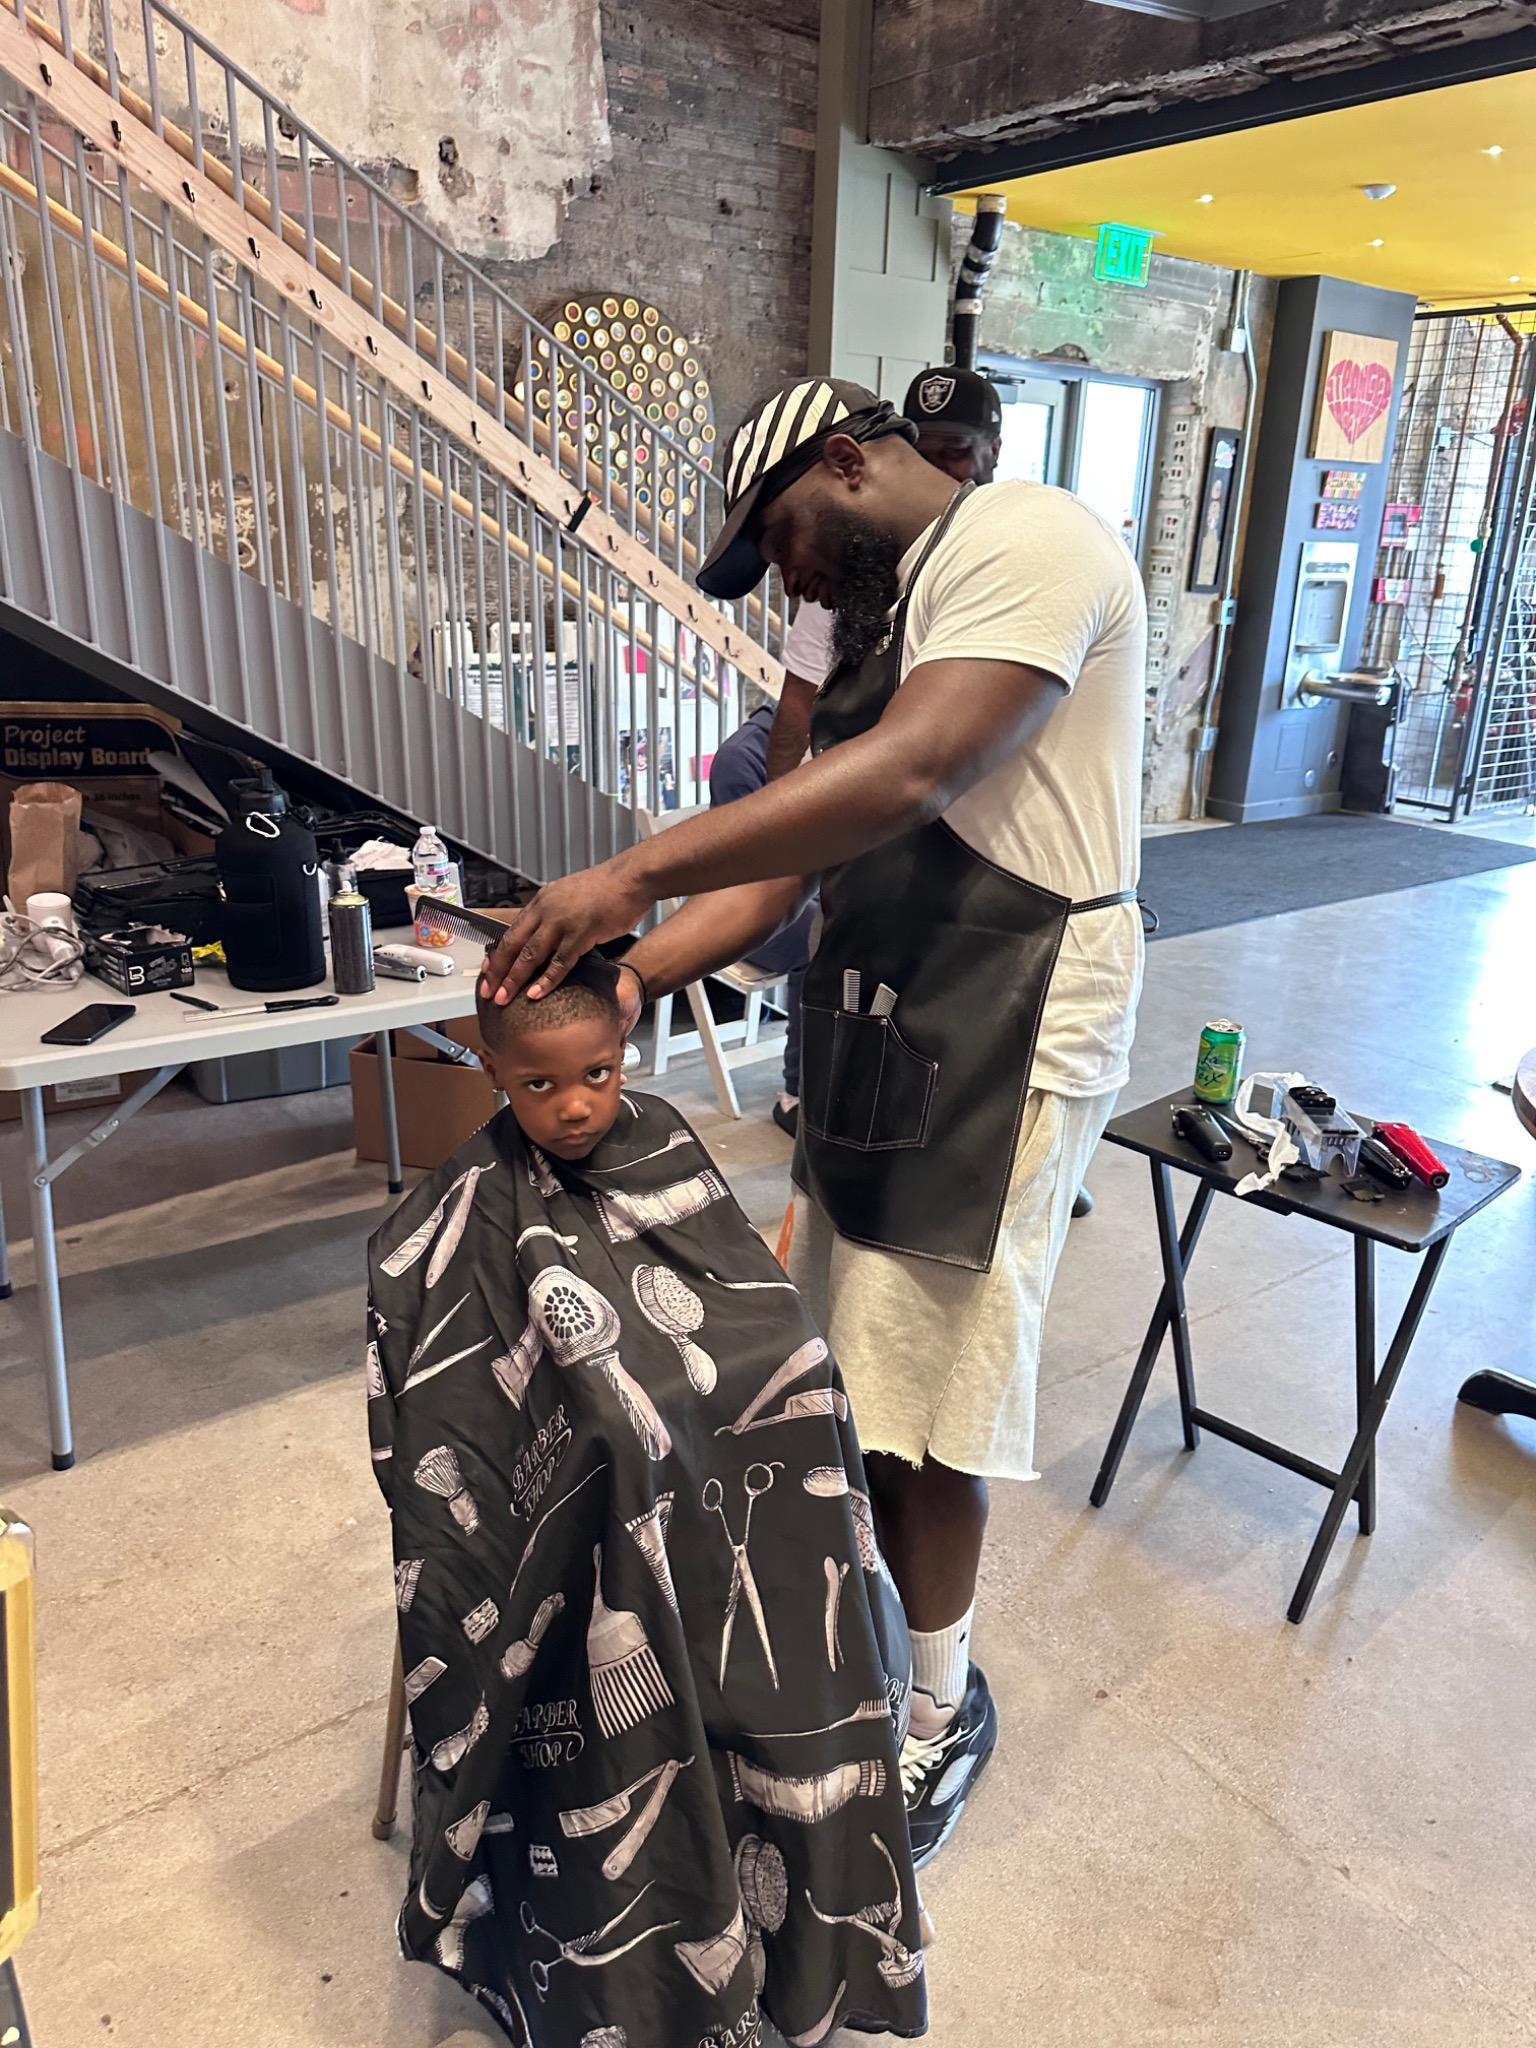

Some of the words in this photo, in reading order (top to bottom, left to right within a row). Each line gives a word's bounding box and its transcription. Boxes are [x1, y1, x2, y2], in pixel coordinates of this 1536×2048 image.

[1105, 230, 1149, 280] EXIT
[4, 723, 87, 749] Project
[4, 746, 85, 770] Display
[91, 746, 150, 766] Board
[512, 1404, 569, 1490] BARBER
[524, 1456, 556, 1522] SHOP
[513, 1699, 582, 1734] ARBER
[521, 1741, 562, 1769] SHOP
